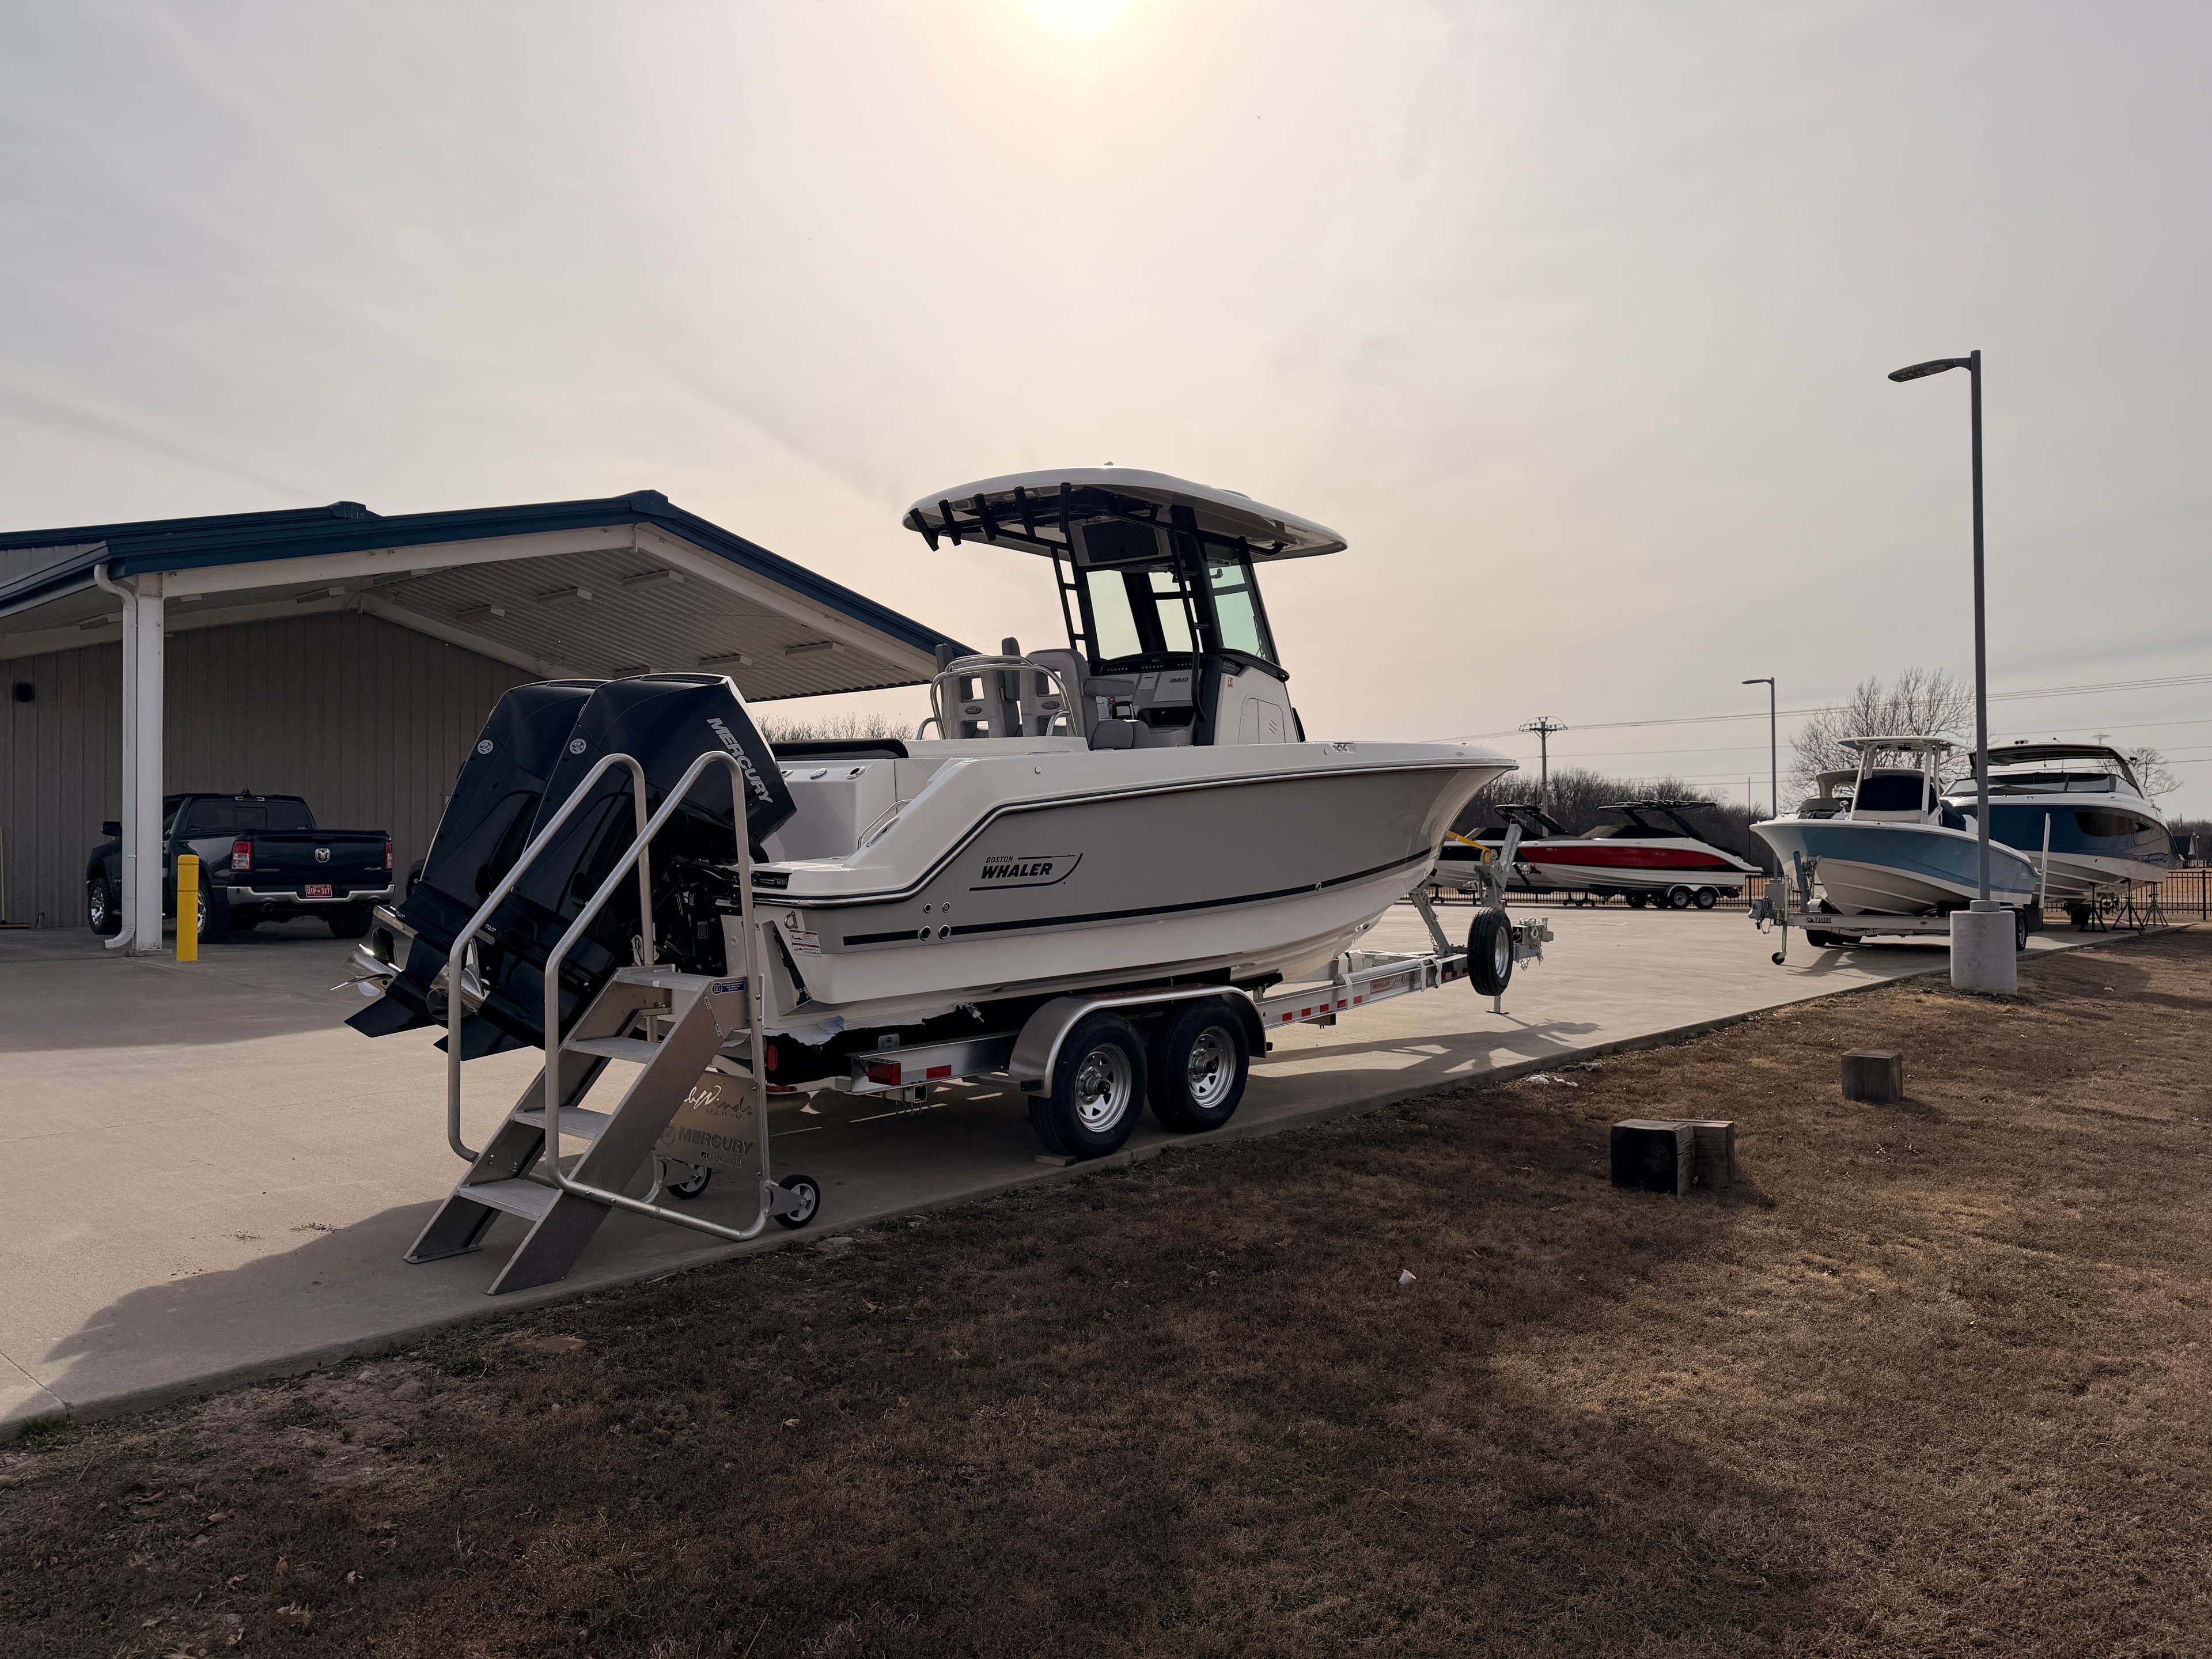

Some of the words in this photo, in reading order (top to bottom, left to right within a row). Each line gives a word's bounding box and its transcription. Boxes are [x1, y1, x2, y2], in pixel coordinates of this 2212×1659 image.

[706, 718, 774, 803] MERCURY
[982, 863, 1052, 879] WHALER
[706, 1109, 745, 1121] MARINA
[679, 1126, 755, 1156] MERCURY
